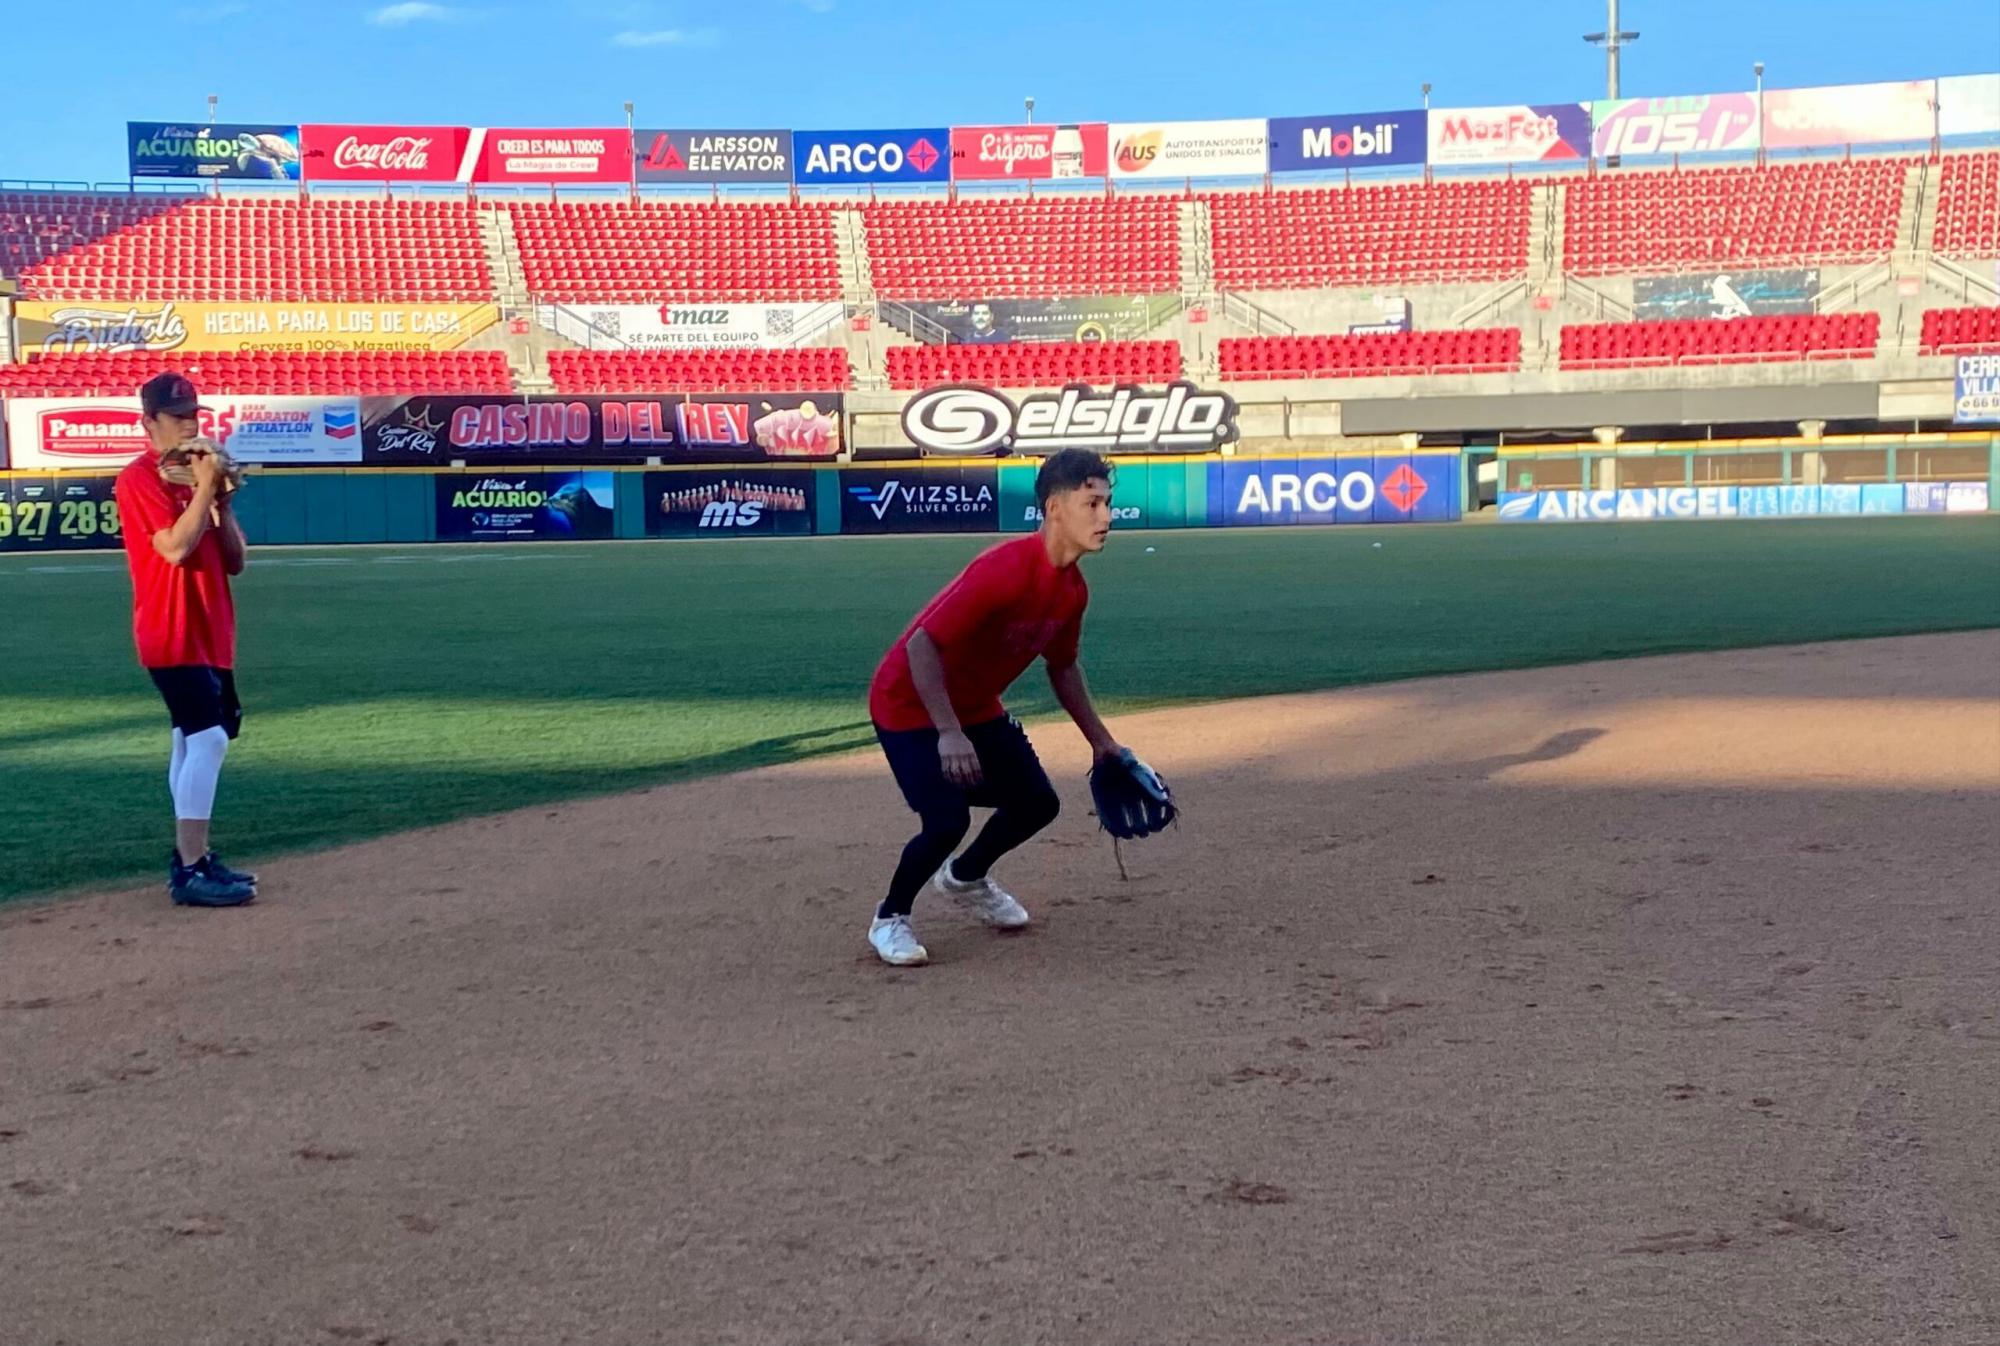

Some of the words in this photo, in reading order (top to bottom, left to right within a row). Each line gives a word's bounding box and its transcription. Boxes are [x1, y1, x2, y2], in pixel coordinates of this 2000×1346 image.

[1302, 123, 1394, 158] Mobil
[1603, 110, 1732, 156] 105.1
[136, 138, 238, 157] ACUARIO!
[333, 136, 432, 170] Coca-Cola
[545, 139, 572, 154] PARA
[572, 139, 606, 154] TODOS
[690, 137, 778, 153] LARSSON
[979, 133, 1050, 175] Ligero
[1118, 145, 1157, 161] AUS
[688, 154, 785, 171] ELEVATOR
[805, 143, 903, 173] ARCO
[205, 311, 271, 334] HECHA
[276, 311, 329, 333] PARA
[336, 311, 375, 333] LOS
[381, 311, 405, 333] DE
[411, 311, 462, 334] CASA
[657, 304, 730, 325] tmaz
[239, 341, 303, 351] Cerveza
[308, 340, 350, 351] 100%
[353, 340, 431, 351] Mazatleca
[629, 332, 644, 343] SÉ
[646, 333, 684, 343] PARTE
[687, 333, 709, 343] DEL
[713, 332, 759, 342] EQUIPO
[240, 411, 311, 423] MARATON
[450, 402, 590, 447] CASINO
[601, 401, 673, 444] DEL
[676, 402, 749, 446] REY
[49, 419, 146, 437] Panamá
[247, 422, 314, 433] TRIATLON
[378, 435, 408, 451] Del
[452, 491, 548, 508] ACUARIO!
[901, 486, 992, 503] VIZSLA
[1237, 471, 1376, 513] ARCO
[906, 503, 948, 513] SILVER
[955, 503, 992, 512] CORP.
[1538, 489, 1738, 519] ARCANGEL
[16, 502, 53, 537] 27
[59, 501, 98, 535] 28
